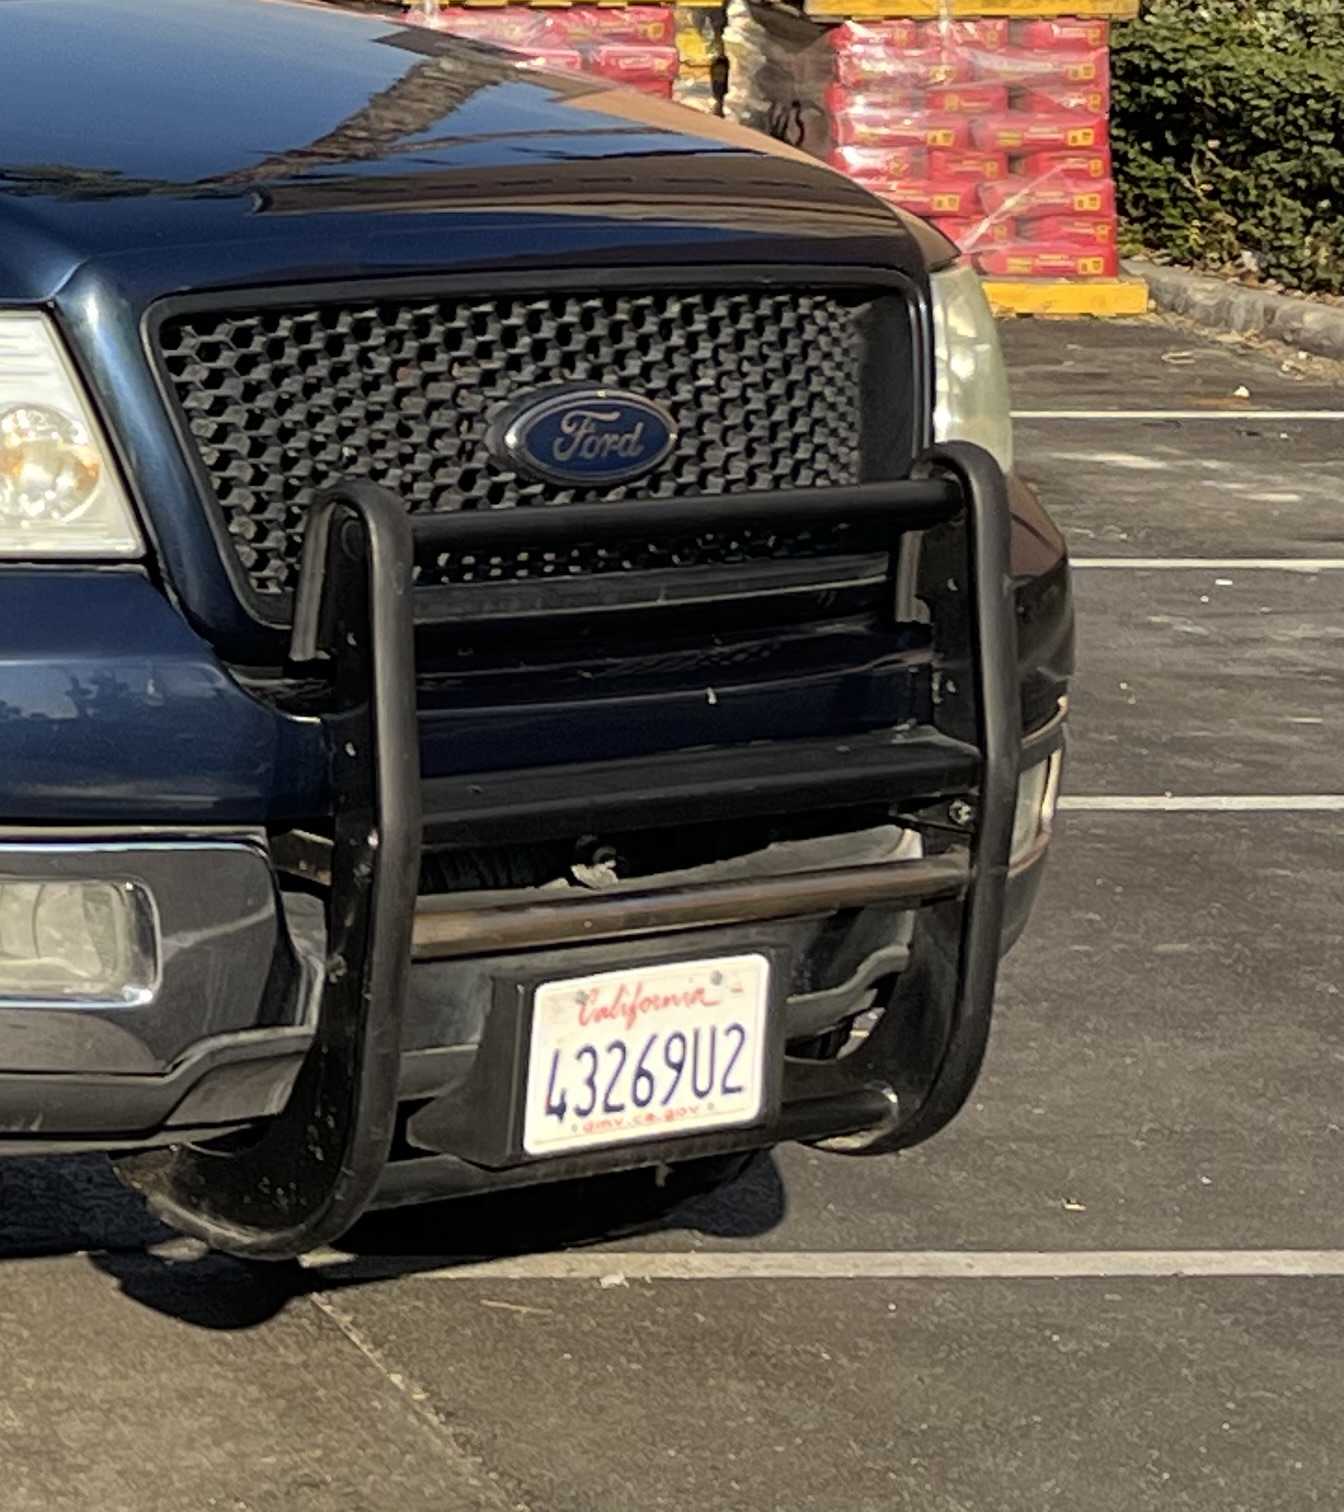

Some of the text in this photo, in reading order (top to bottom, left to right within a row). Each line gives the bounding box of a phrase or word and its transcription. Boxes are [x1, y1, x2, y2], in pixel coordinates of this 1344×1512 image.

[552, 409, 645, 462] Ford
[577, 982, 720, 1031] California
[545, 1022, 746, 1123] 43269U2
[581, 1105, 701, 1134] dmv.ca.gov
